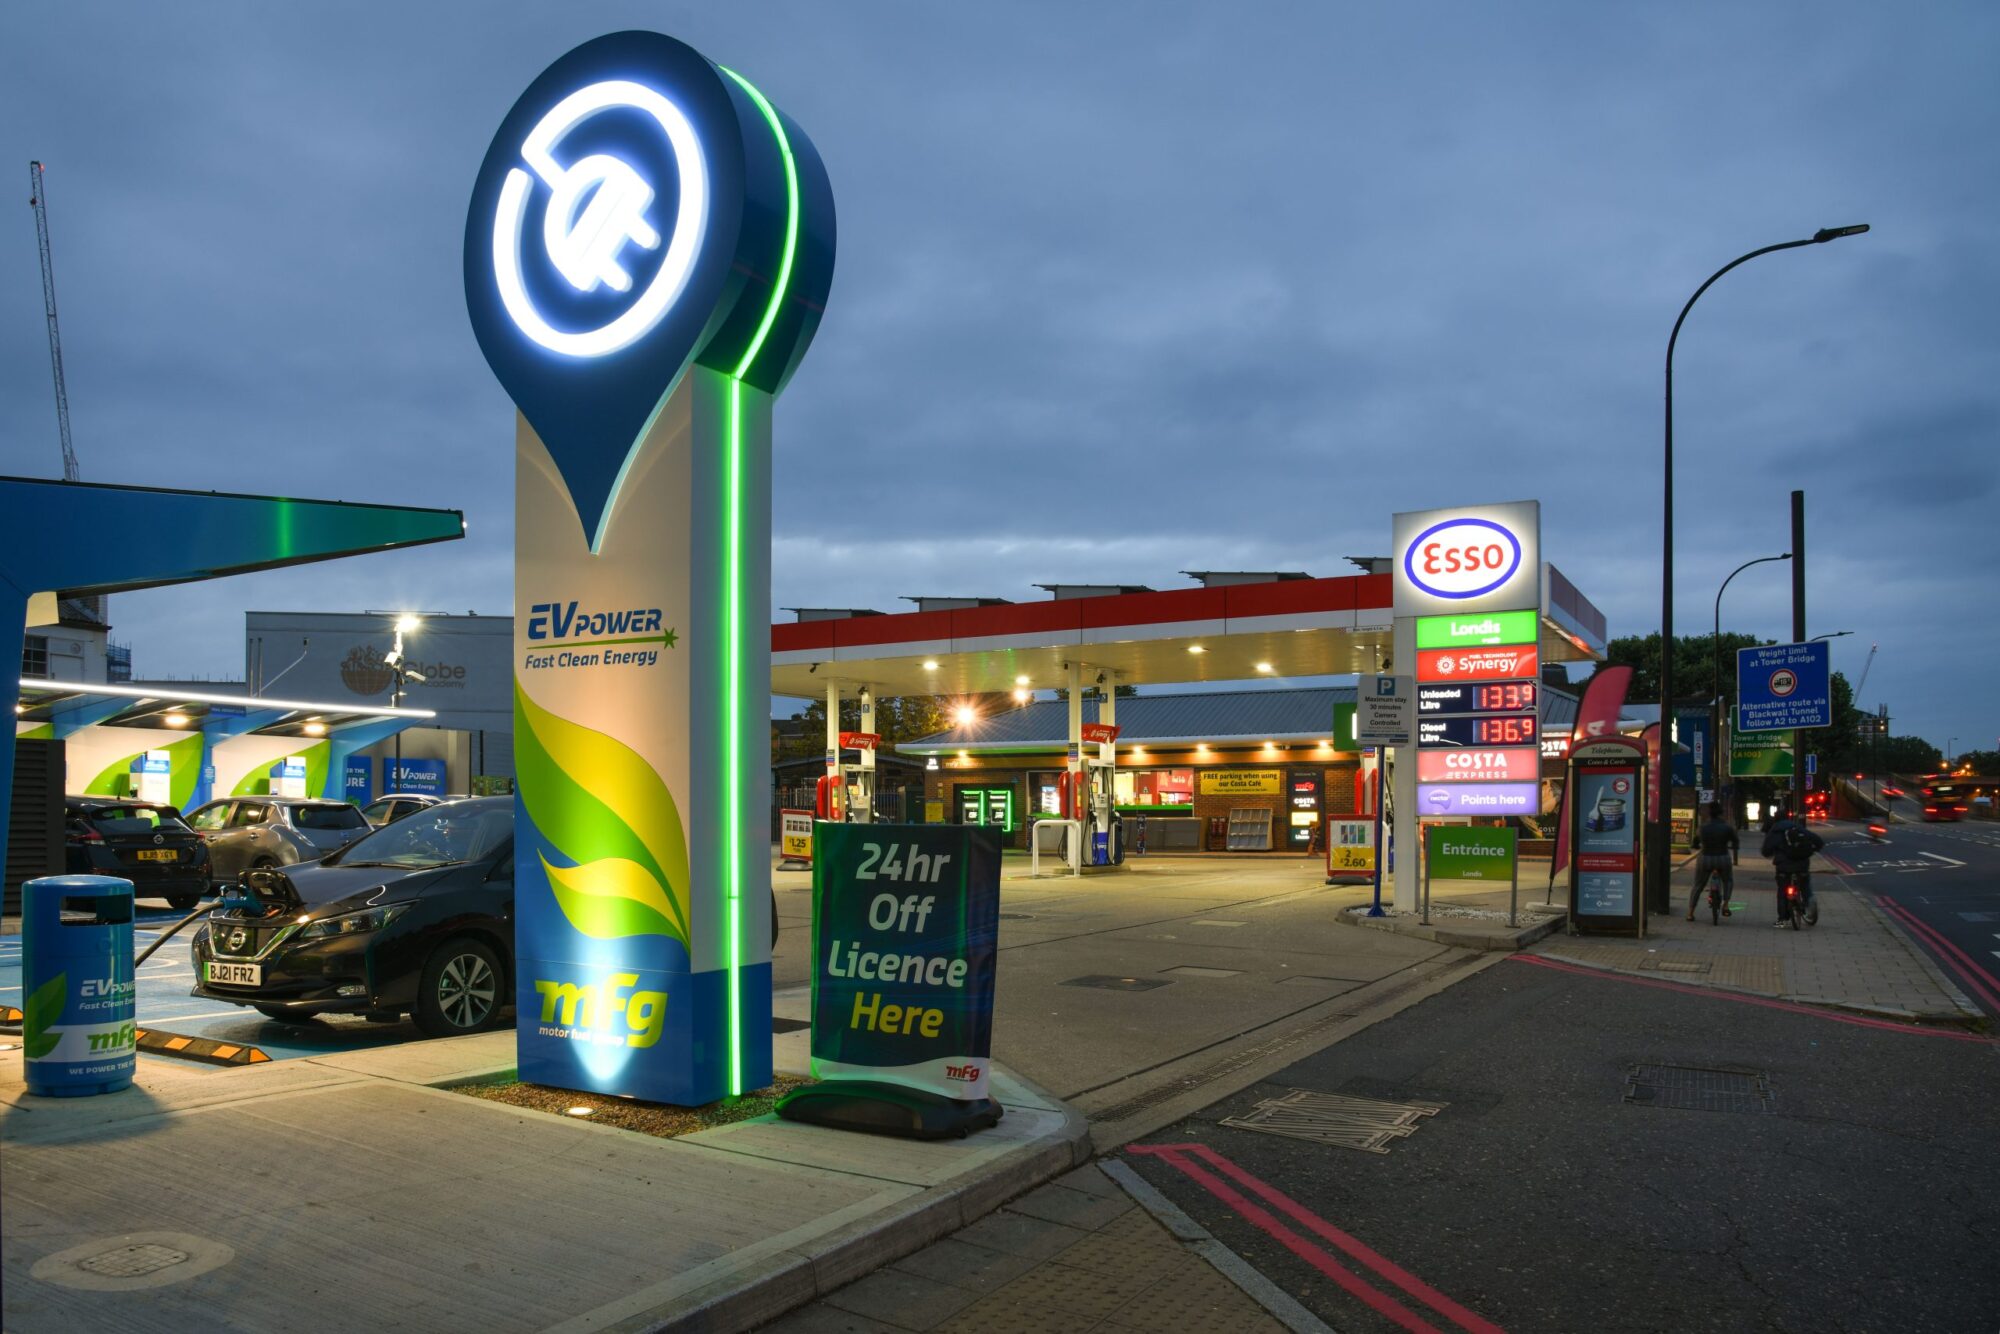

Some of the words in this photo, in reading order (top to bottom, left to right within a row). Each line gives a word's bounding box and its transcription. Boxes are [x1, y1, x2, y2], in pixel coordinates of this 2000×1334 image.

[1450, 619, 1501, 636] Londis
[525, 655, 555, 669] Fast
[558, 652, 599, 667] Clean
[603, 650, 658, 667] Energy
[1758, 649, 1786, 658] Weight
[1459, 657, 1518, 673] Synergy
[1761, 658, 1785, 666] Tower
[1787, 655, 1816, 664] Bridge
[1394, 696, 1408, 704] stay
[1420, 689, 1461, 699] Unleaded
[1481, 684, 1533, 709] 133.9
[1420, 701, 1440, 710] Litre
[1741, 702, 1787, 711] Alternative
[1788, 699, 1811, 708] route
[1748, 710, 1788, 719] Blackwall
[1791, 707, 1819, 716] Tunnel
[1746, 719, 1772, 727] follow
[1774, 718, 1786, 726] A2
[1799, 715, 1822, 724] A102
[1420, 723, 1446, 732] Diesel
[1481, 719, 1533, 742] 136.9
[1420, 734, 1440, 742] Litre
[1757, 734, 1782, 742] Bridge
[1591, 746, 1623, 755] Telephone
[1445, 753, 1508, 769] COSTA
[1455, 771, 1508, 779] EXPRESS
[1461, 794, 1497, 805] Points
[1499, 794, 1526, 805] here
[1345, 849, 1351, 857] 2
[855, 842, 951, 883] 24hr
[868, 893, 935, 933] Off
[827, 940, 968, 988] Licence
[210, 965, 231, 981] BJ21
[233, 967, 254, 983] FRZ
[79, 1002, 100, 1011] Fast
[101, 999, 124, 1009] Clean
[850, 991, 944, 1038] Here
[538, 1026, 570, 1039] motor
[69, 1067, 84, 1075] WE
[86, 1064, 116, 1074] POWER
[946, 1065, 980, 1082] mfg
